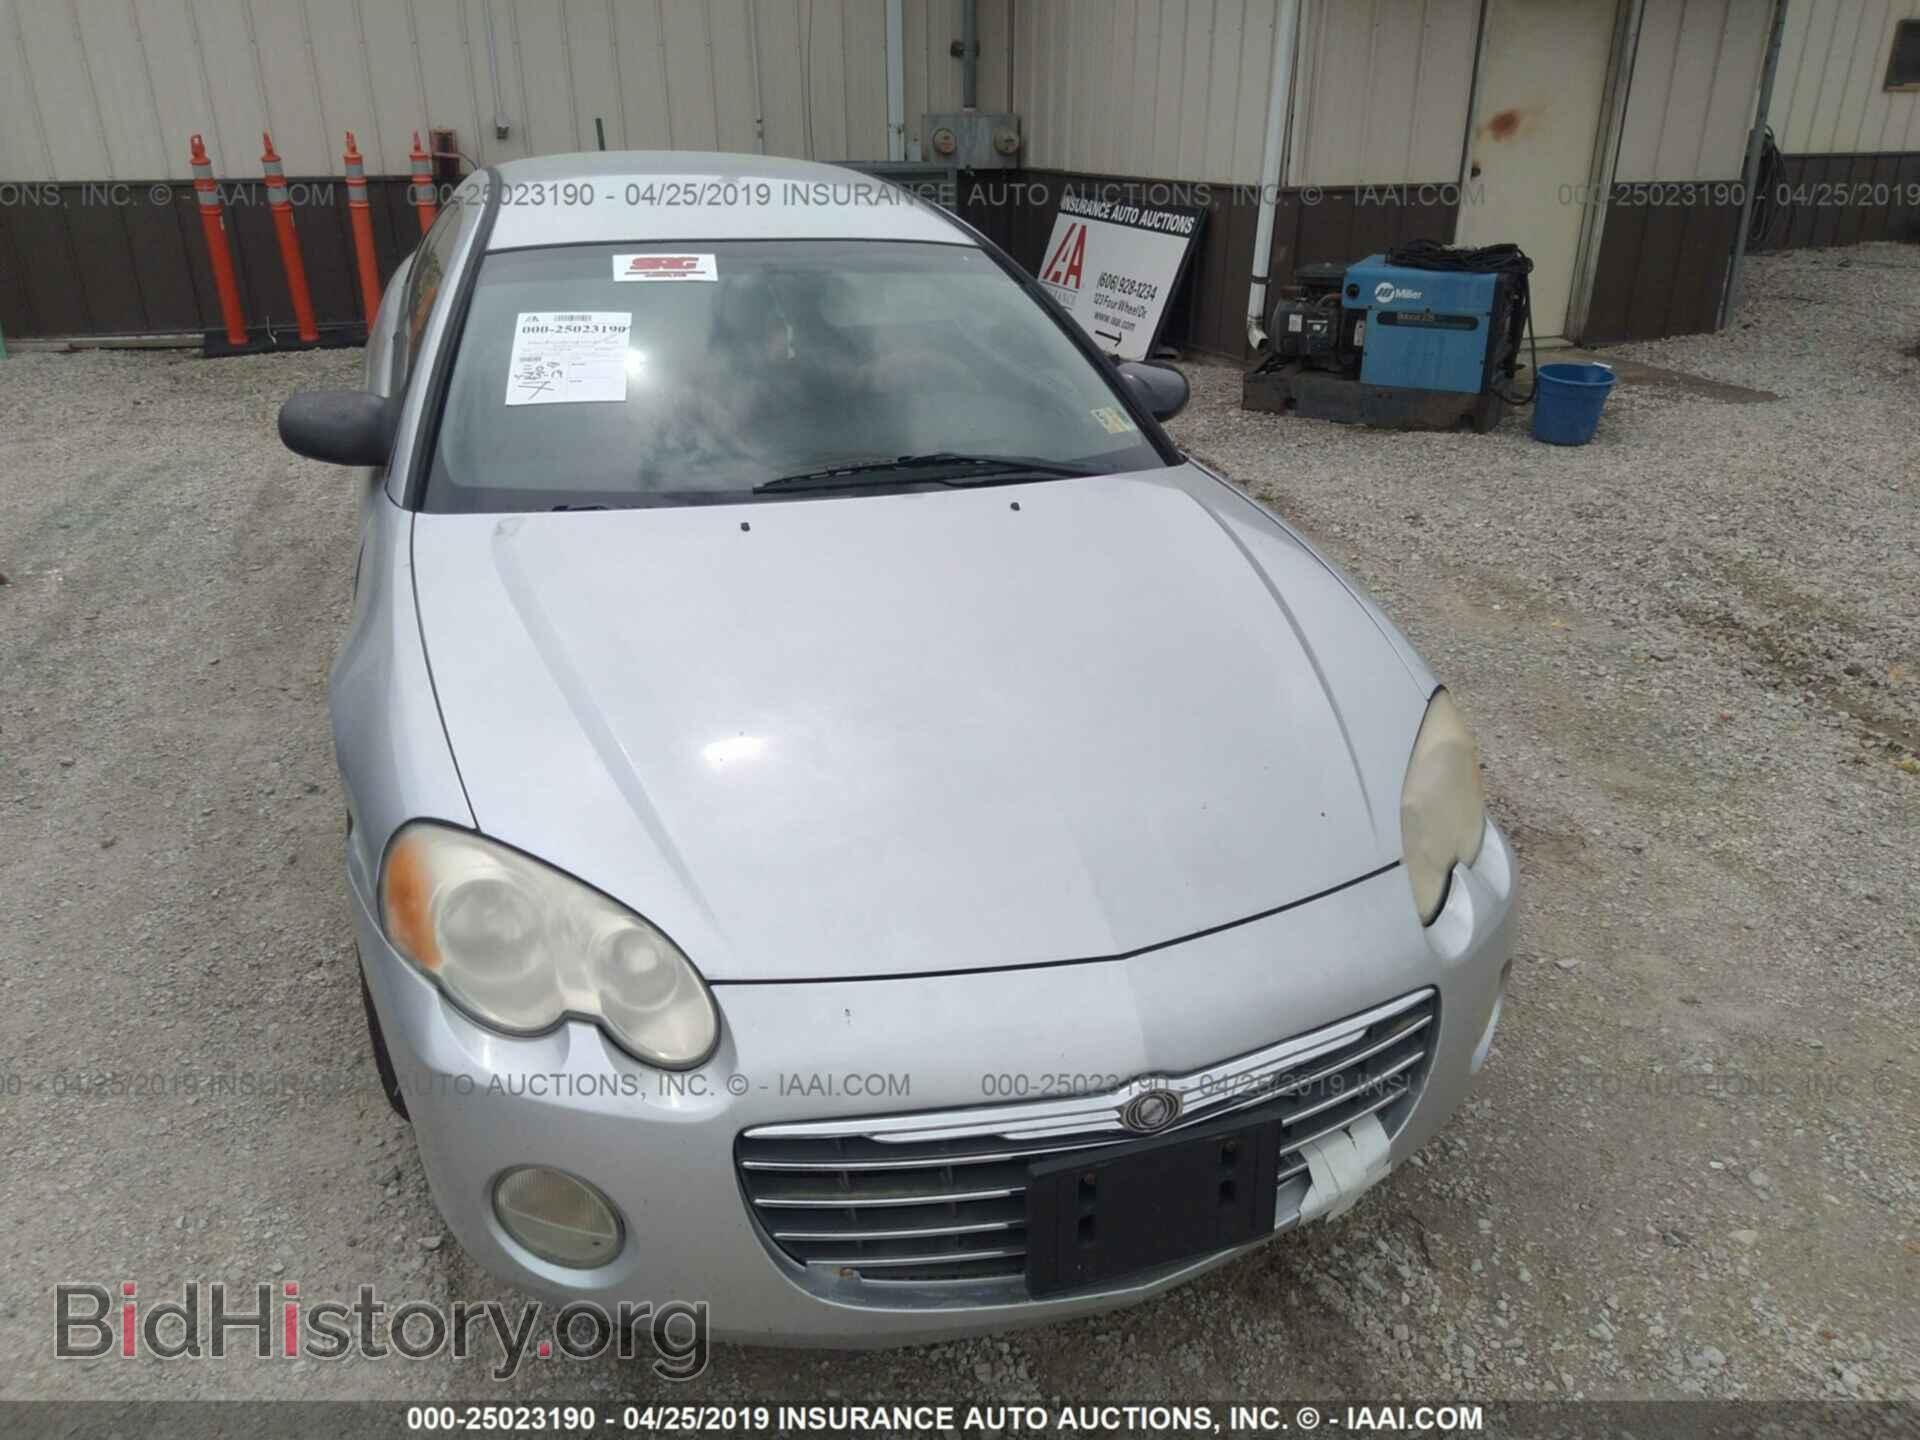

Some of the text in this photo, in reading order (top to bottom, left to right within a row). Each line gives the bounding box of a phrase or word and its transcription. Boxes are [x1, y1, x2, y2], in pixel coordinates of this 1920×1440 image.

[1060, 196, 1196, 235] INSURANCE AUTO AUCTIONS
[1395, 288, 1424, 300] Miller
[522, 324, 626, 335] 000-25023190
